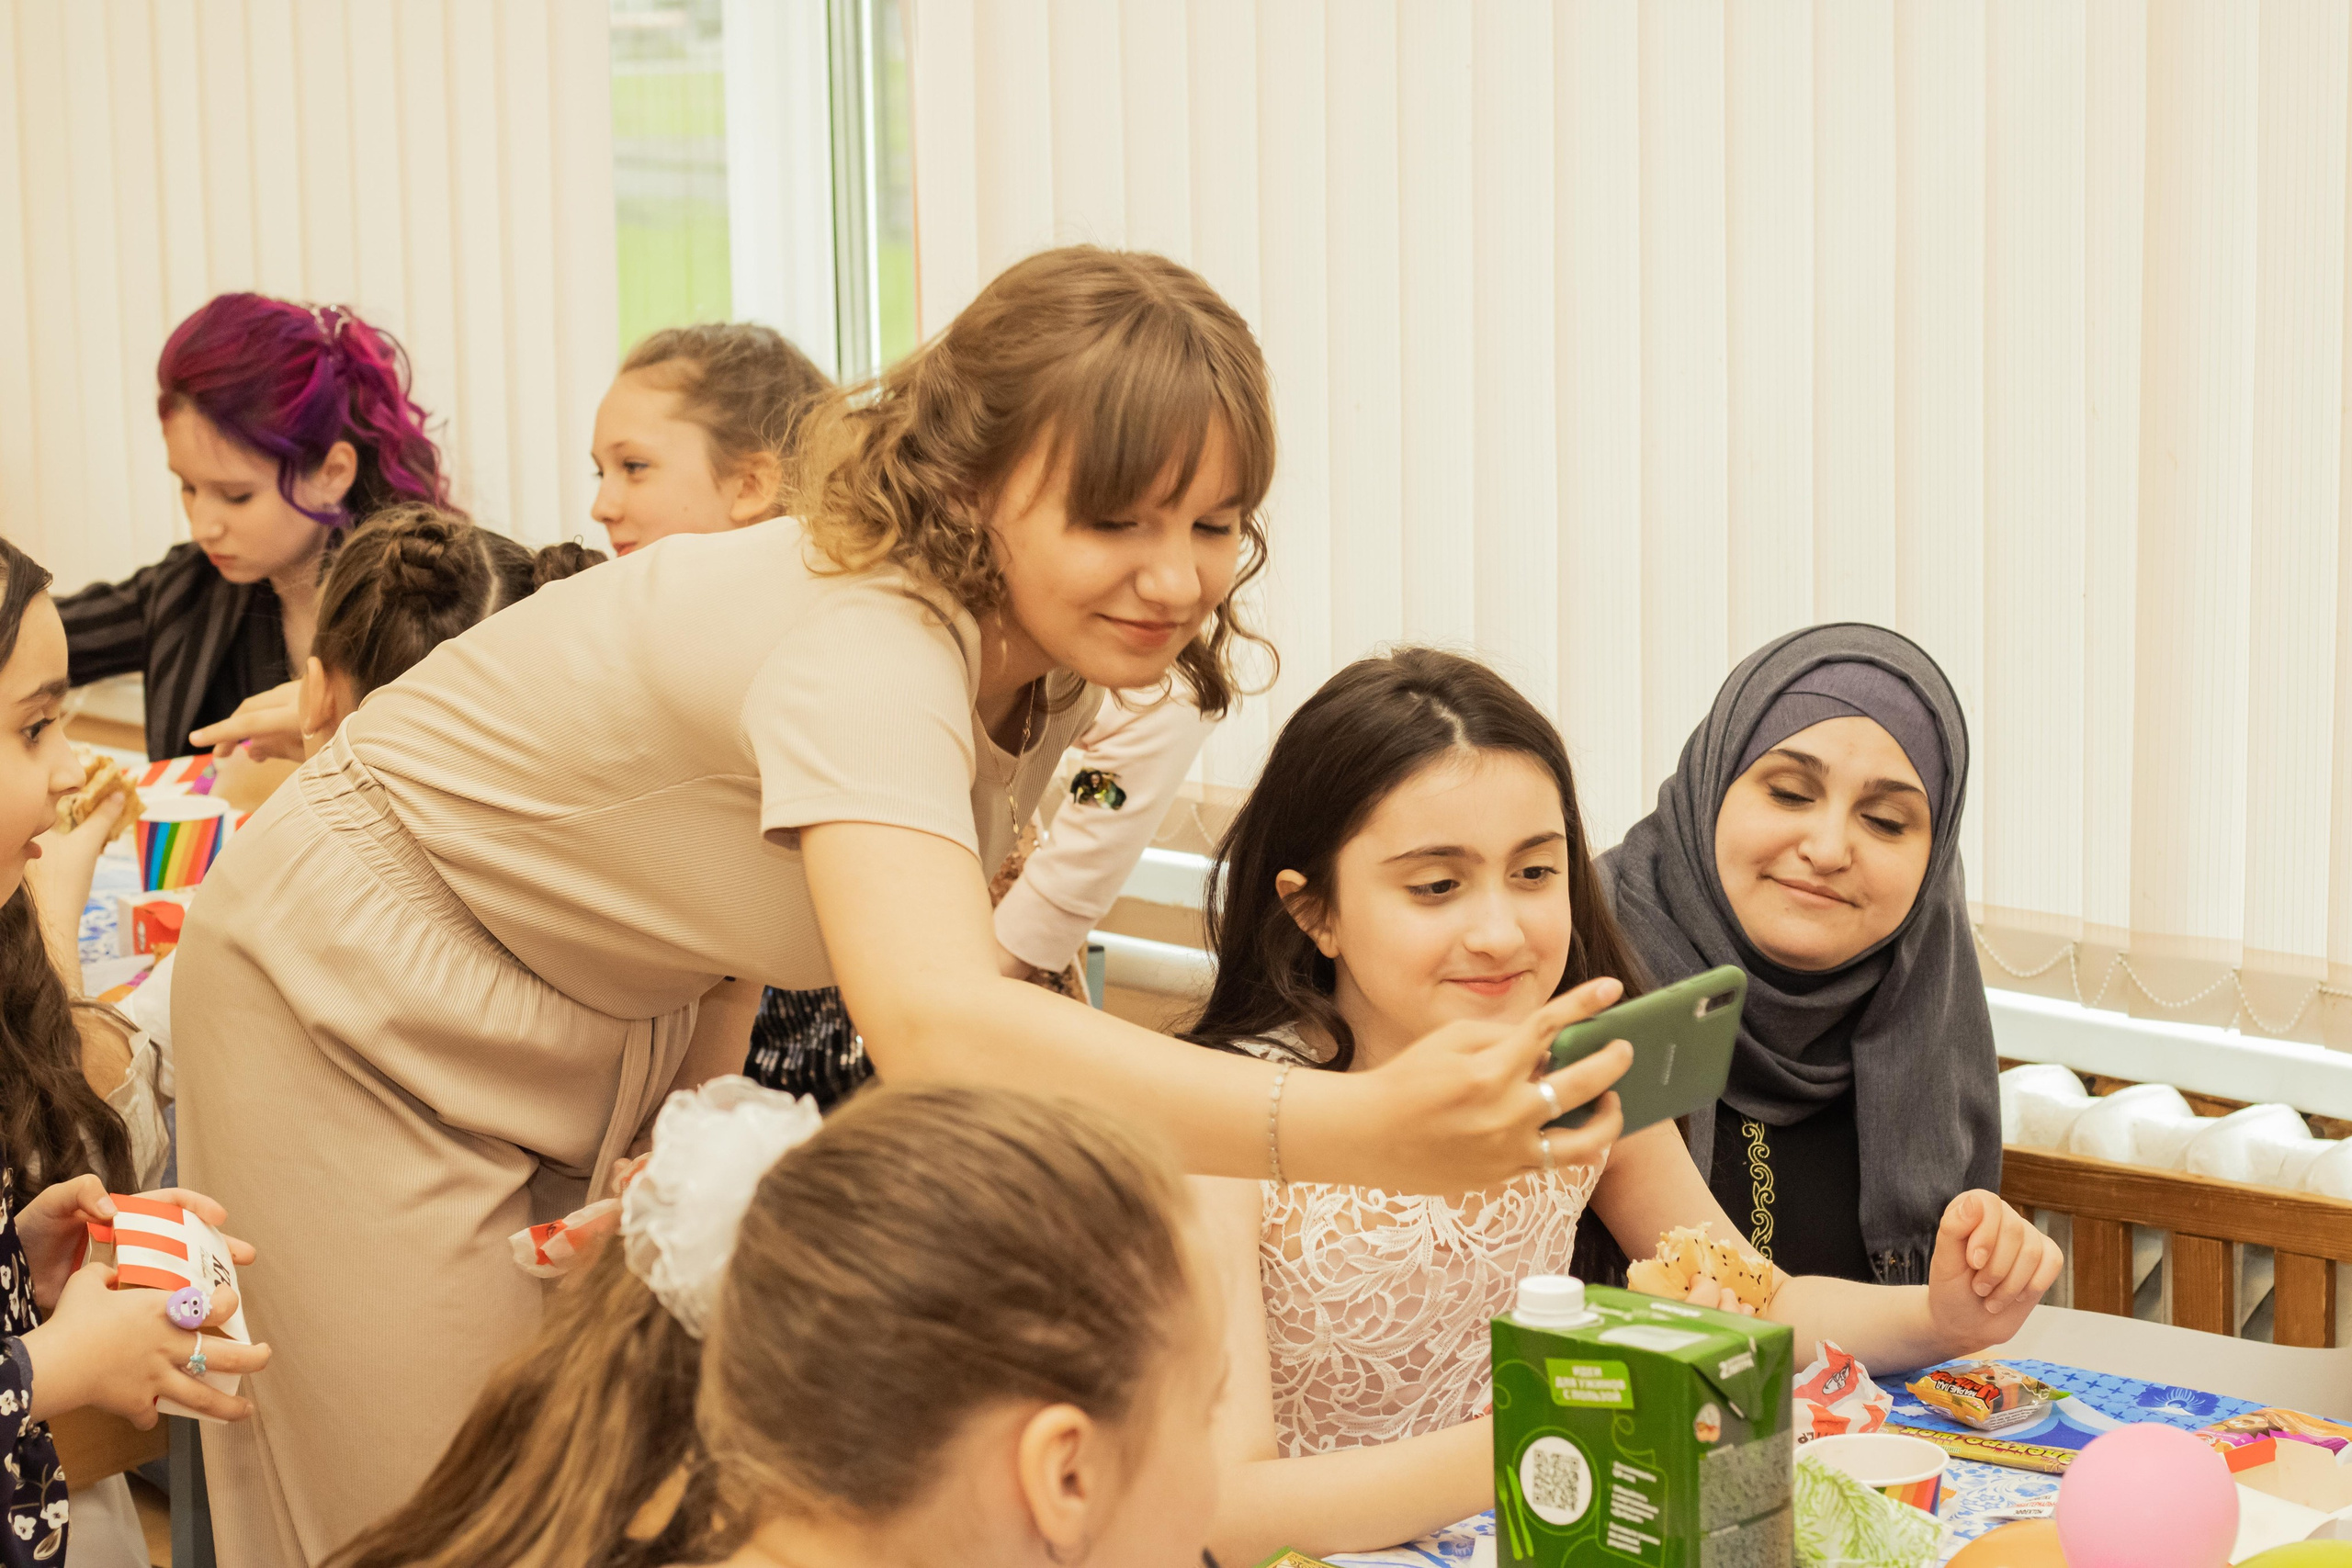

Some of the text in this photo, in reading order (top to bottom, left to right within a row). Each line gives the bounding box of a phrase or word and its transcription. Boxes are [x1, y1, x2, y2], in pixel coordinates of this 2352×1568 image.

[212, 1253, 232, 1288] KF
[1555, 1375, 1577, 1388] ДЛЯ
[1935, 1380, 1977, 1397] МАРМЕЛАД
[1900, 1426, 1958, 1440] шок
